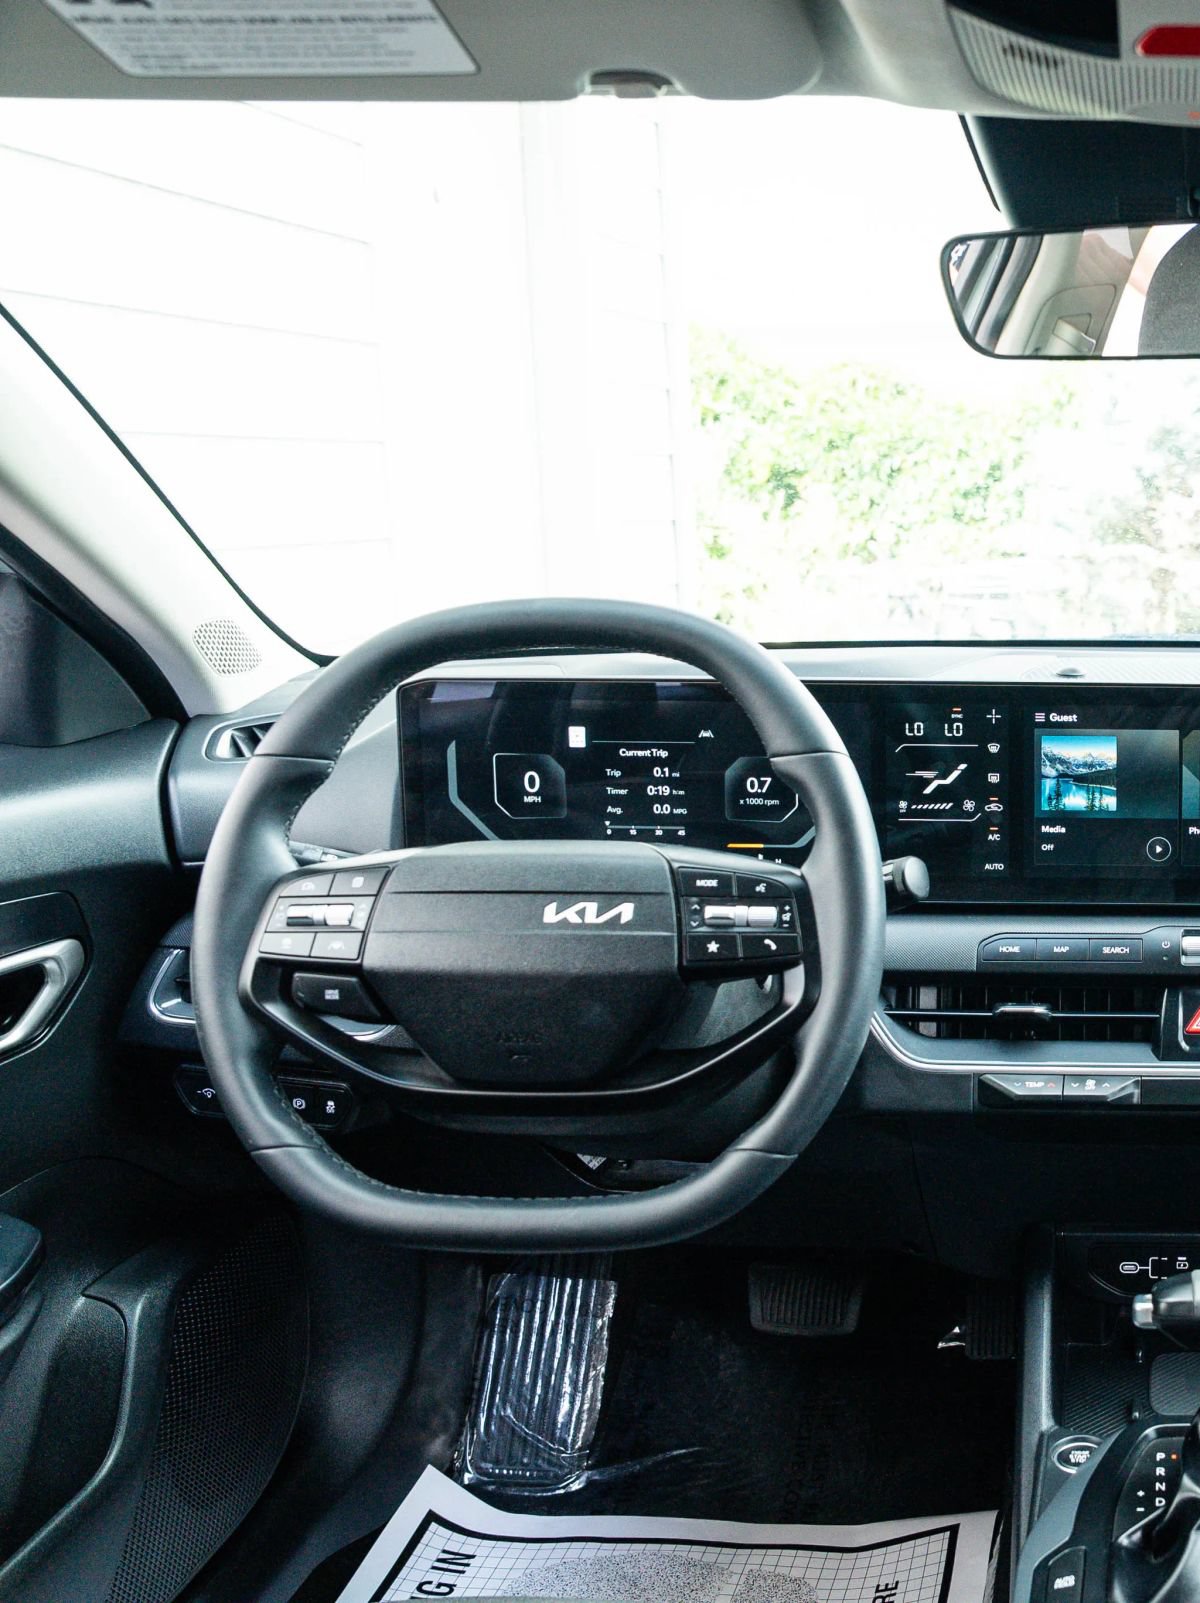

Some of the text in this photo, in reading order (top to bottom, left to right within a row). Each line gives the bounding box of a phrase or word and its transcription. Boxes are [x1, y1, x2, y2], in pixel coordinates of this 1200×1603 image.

[1050, 713, 1078, 722] Guest
[905, 722, 924, 736] LO
[945, 723, 963, 736] LO
[619, 748, 668, 758] Current Trip
[605, 769, 622, 778] Trip
[653, 767, 670, 778] 0.1
[524, 771, 540, 793] 0
[746, 777, 772, 793] 0.7
[606, 787, 628, 795] Timer
[647, 786, 670, 796] 0:19
[607, 806, 624, 814] Avg.
[653, 804, 671, 814] 0.0
[1041, 825, 1066, 833] Media
[543, 902, 635, 924] KIA
[1156, 1452, 1166, 1462] P
[1156, 1467, 1166, 1476] R
[1155, 1482, 1166, 1492] N
[1155, 1497, 1166, 1506] D
[431, 1549, 477, 1574] IN
